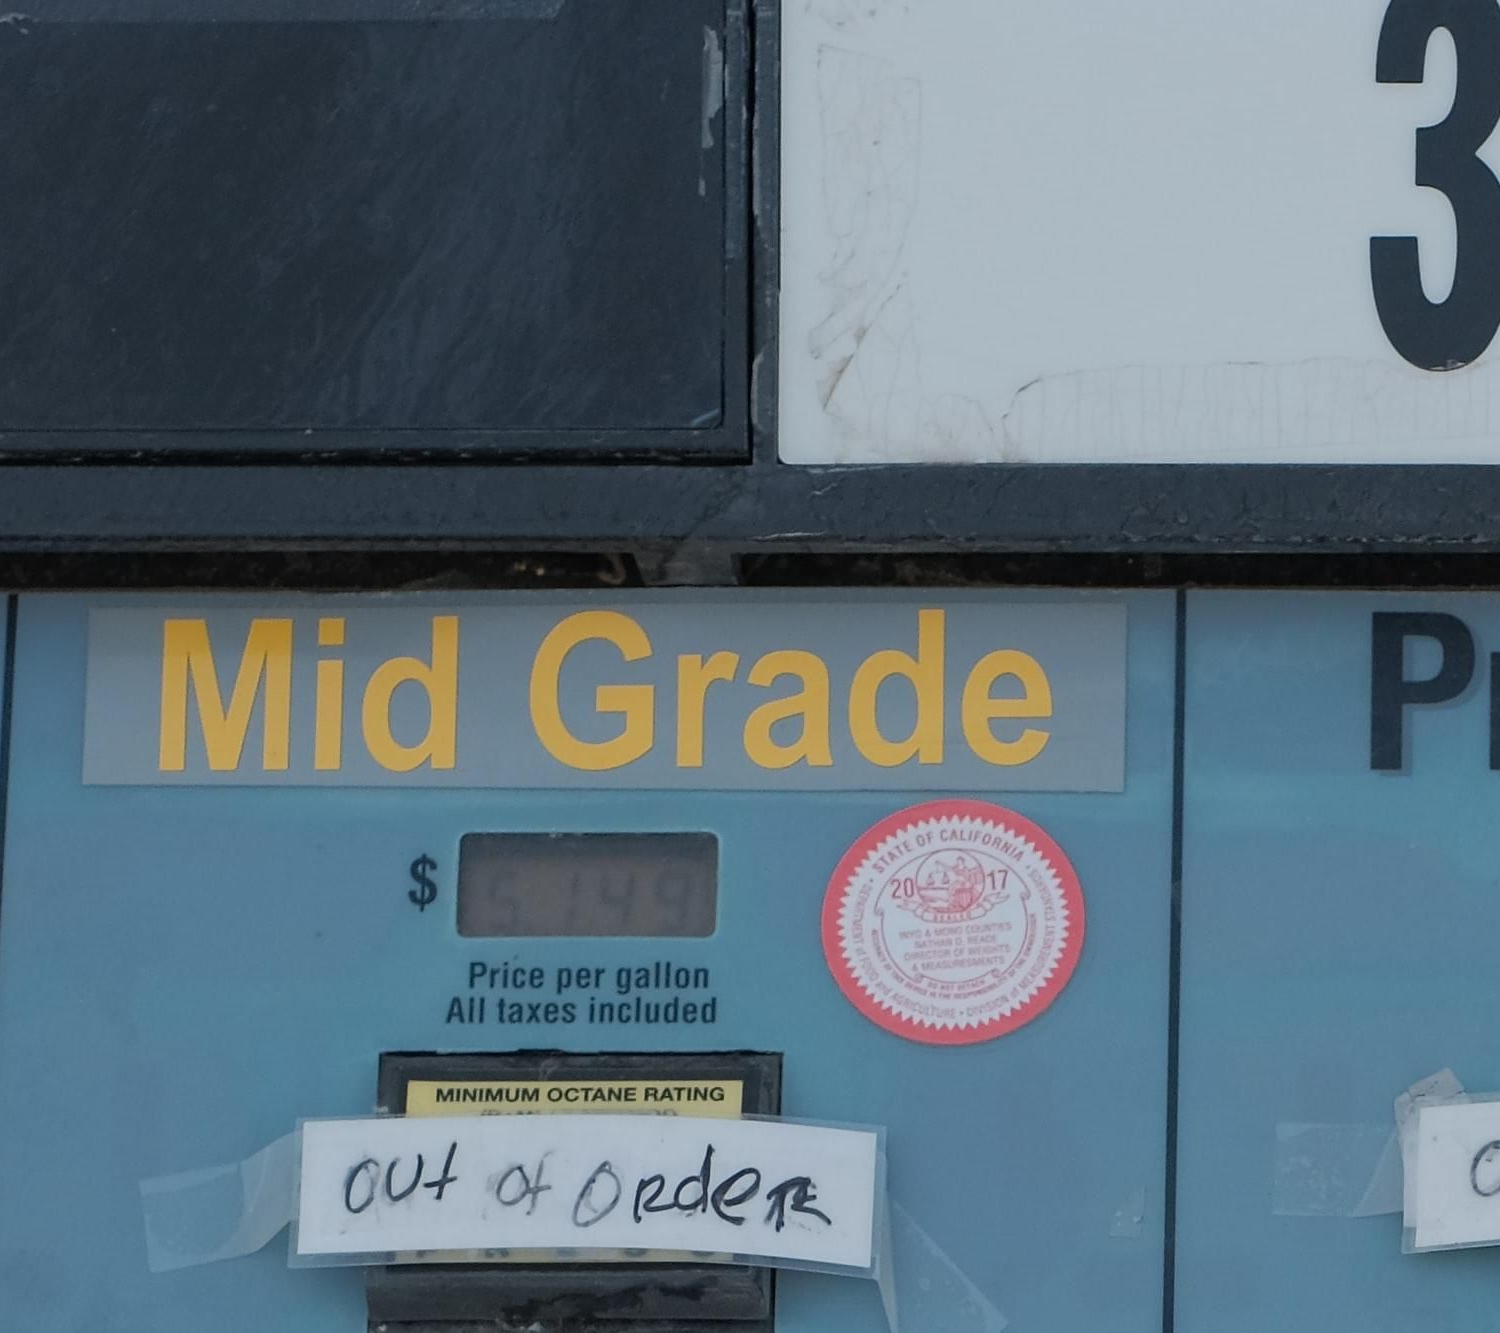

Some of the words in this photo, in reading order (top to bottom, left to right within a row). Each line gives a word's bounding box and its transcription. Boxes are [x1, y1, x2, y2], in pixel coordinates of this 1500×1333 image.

[159, 615, 459, 772] Mid
[529, 609, 1052, 770] Grade
[872, 842, 912, 873] STATE
[917, 830, 934, 846] OF
[940, 828, 1024, 863] CALIFORNIA
[409, 854, 437, 912] $
[469, 961, 544, 989] Price
[557, 966, 605, 994] per
[617, 961, 709, 995] gallon
[446, 997, 485, 1023] All
[498, 998, 576, 1023] taxes
[588, 997, 717, 1023] included
[435, 1087, 541, 1103] MINIMUM
[547, 1087, 638, 1103] OCTANE
[644, 1087, 725, 1103] RATING
